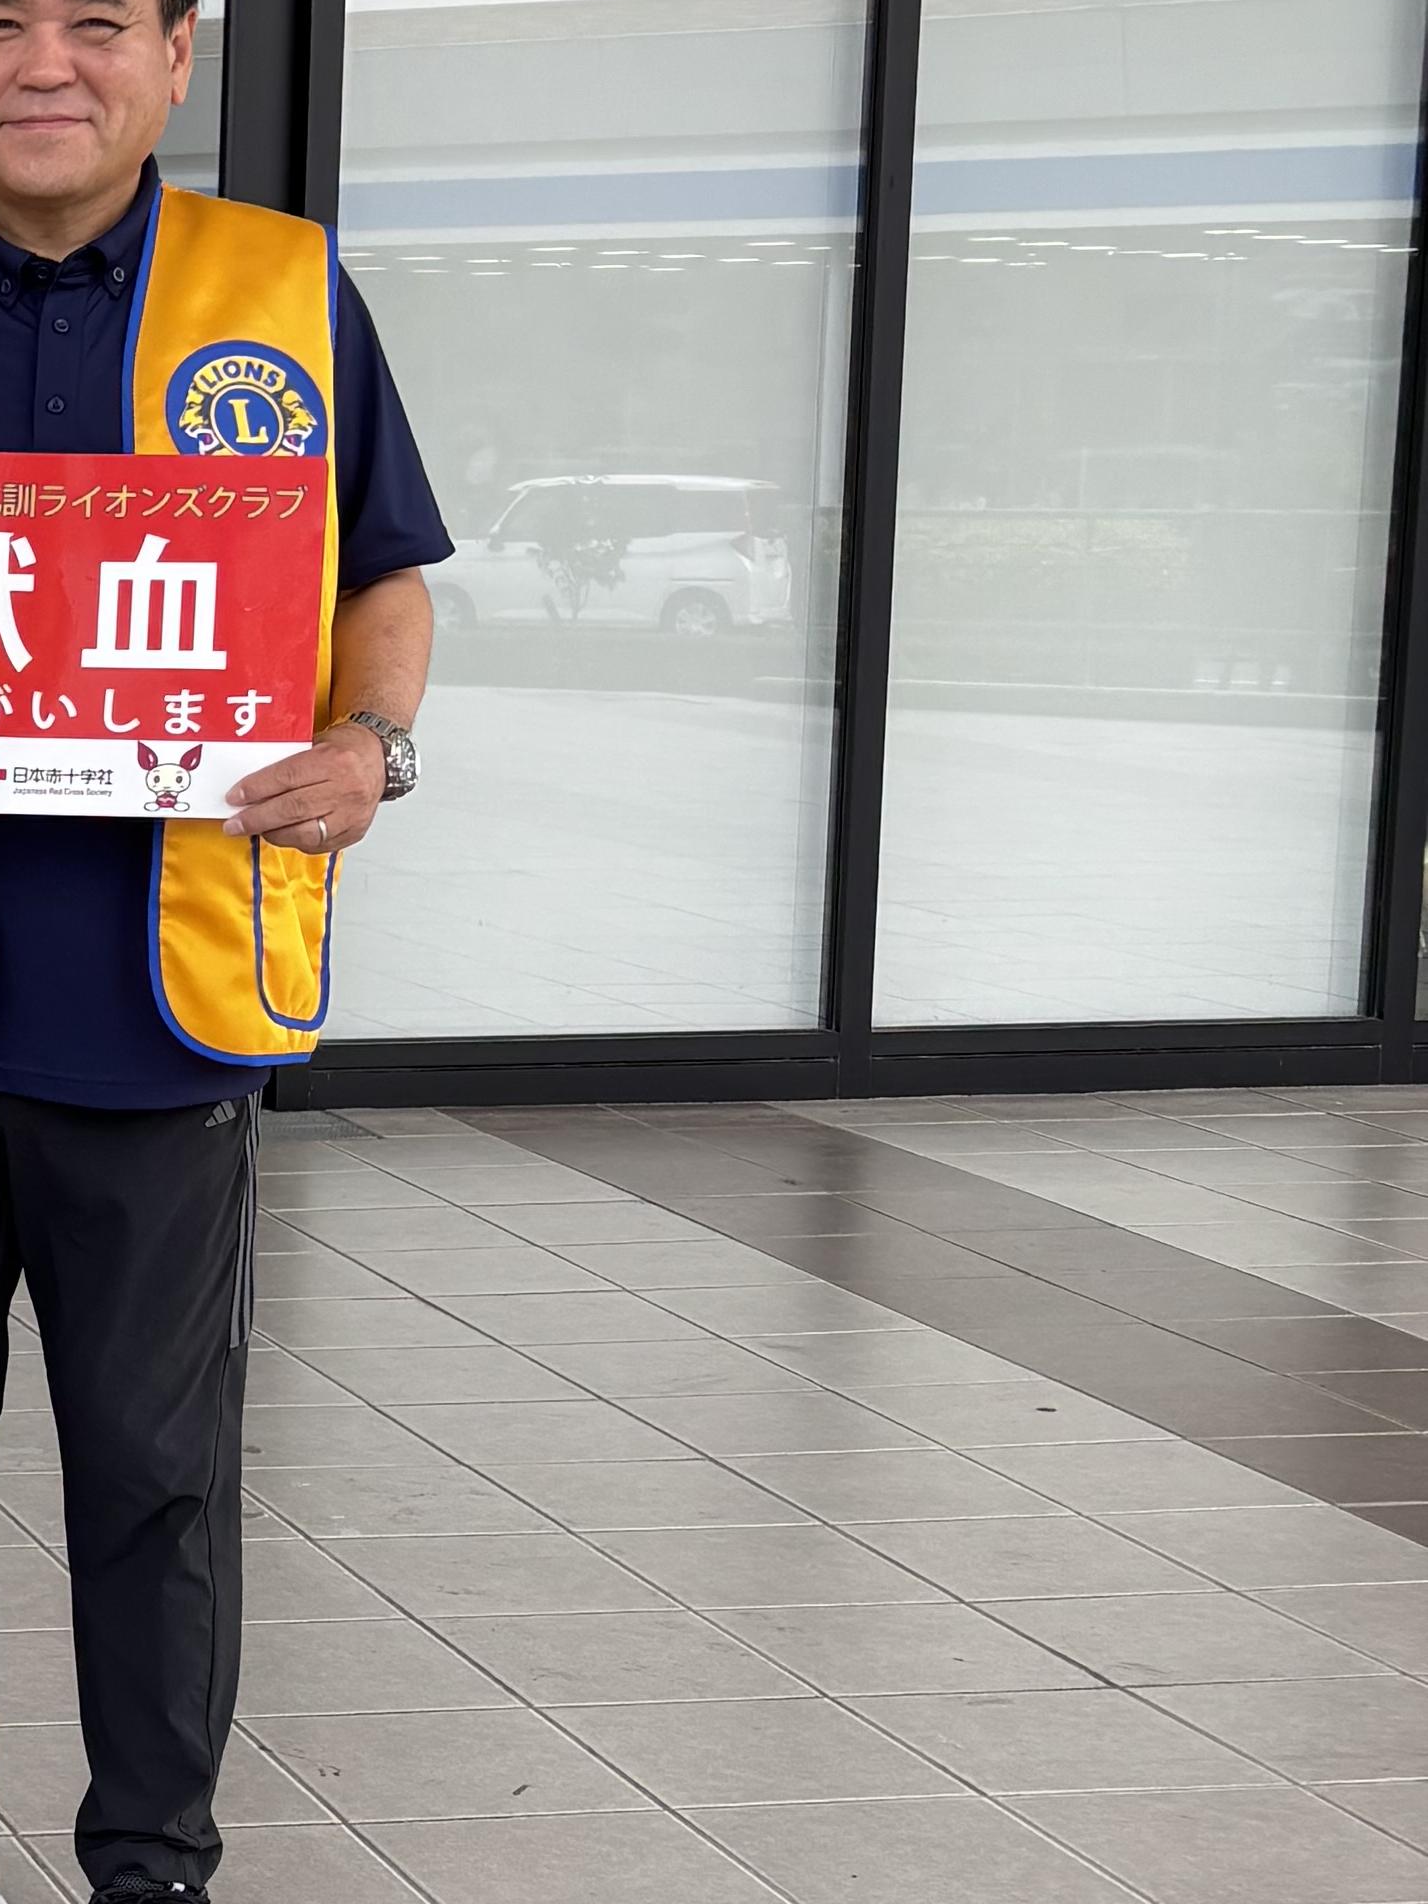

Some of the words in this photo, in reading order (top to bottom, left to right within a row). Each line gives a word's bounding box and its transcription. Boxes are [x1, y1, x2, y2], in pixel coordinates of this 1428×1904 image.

[199, 360, 280, 389] LIONS
[228, 398, 269, 444] L
[13, 767, 113, 784] 日本赤十字社
